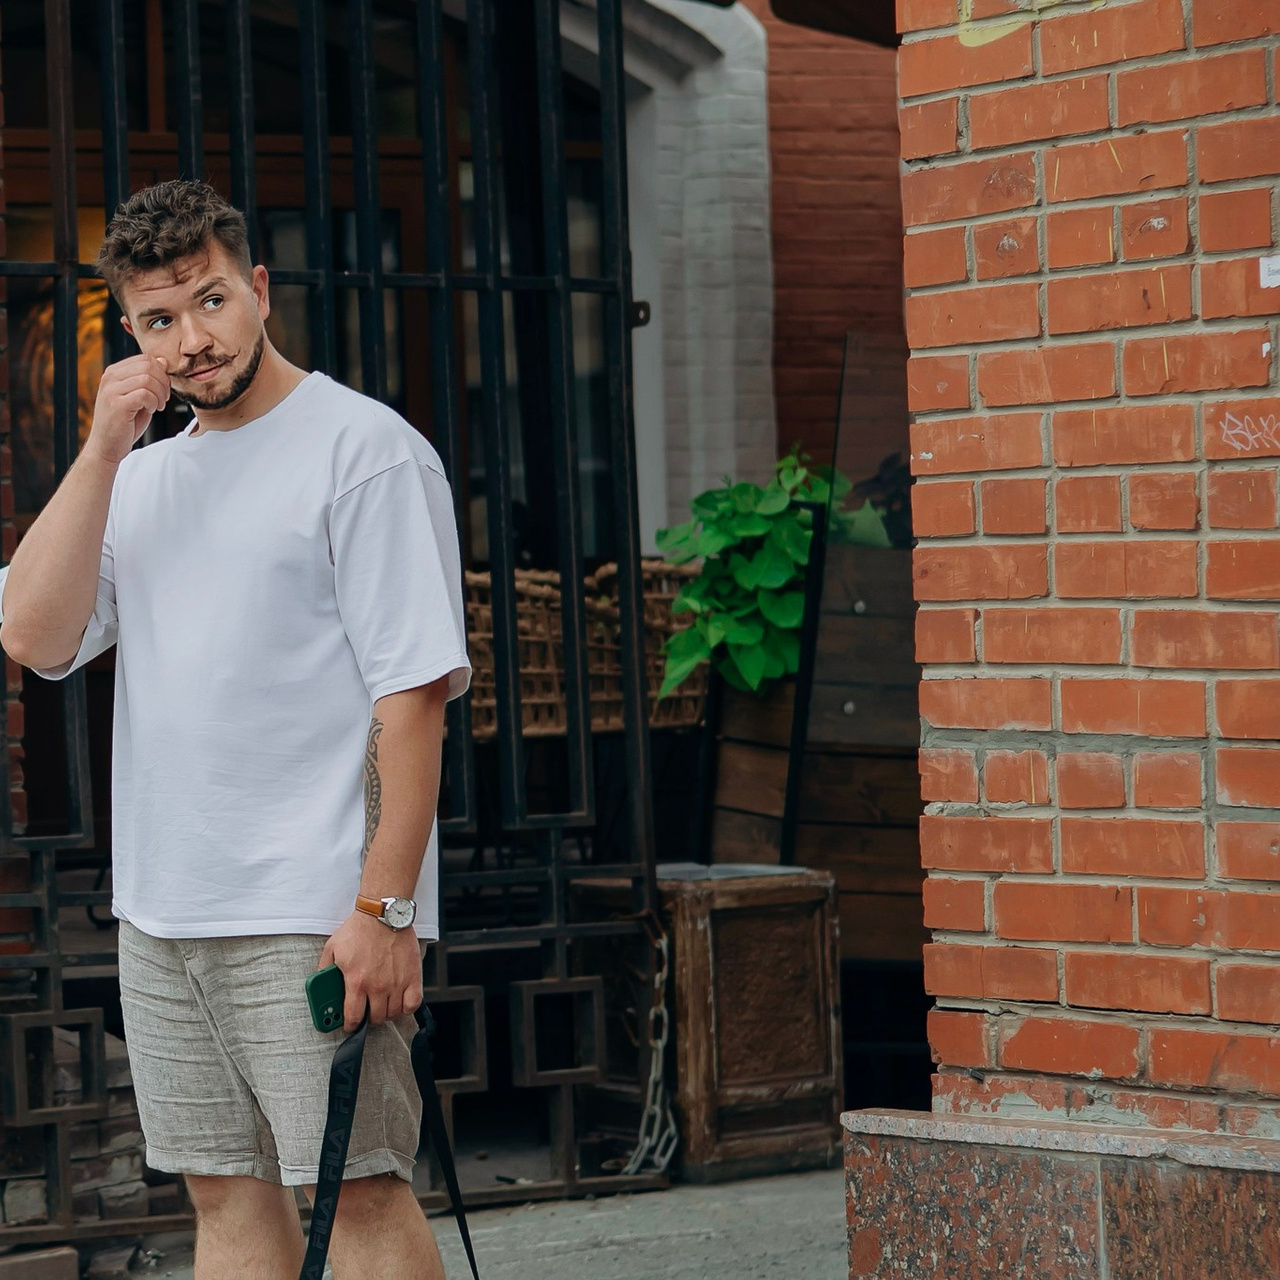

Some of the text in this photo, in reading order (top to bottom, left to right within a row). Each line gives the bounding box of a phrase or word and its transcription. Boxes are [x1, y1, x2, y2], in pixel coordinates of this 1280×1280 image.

[333, 1057, 356, 1115] FILA
[323, 1127, 346, 1182] FILA
[311, 1196, 333, 1250] FILA
